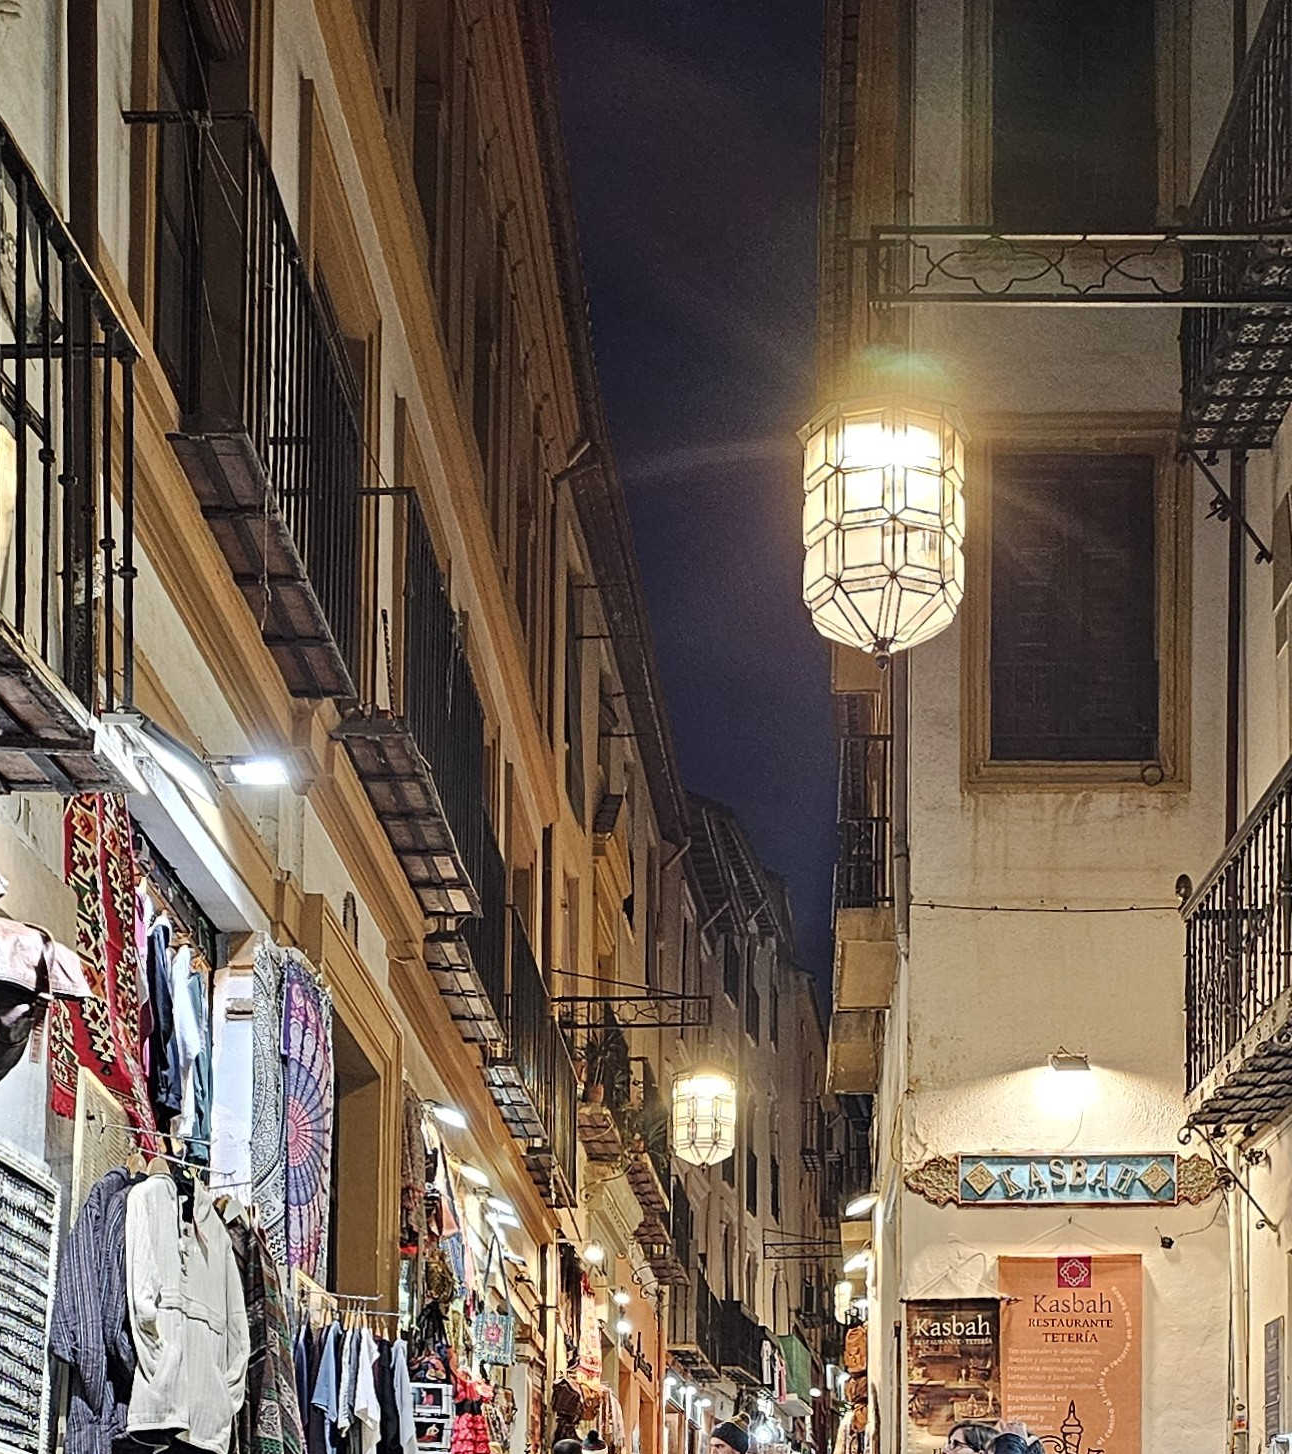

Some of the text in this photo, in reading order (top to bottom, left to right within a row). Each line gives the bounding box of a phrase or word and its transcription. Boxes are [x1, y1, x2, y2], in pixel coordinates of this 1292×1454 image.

[998, 1158, 1137, 1198] KASBAH
[1033, 1292, 1113, 1314] Kasbah
[915, 1314, 991, 1336] Kasbah
[1028, 1318, 1115, 1329] RESTAURANTE
[1042, 1330, 1099, 1343] TETERÍA
